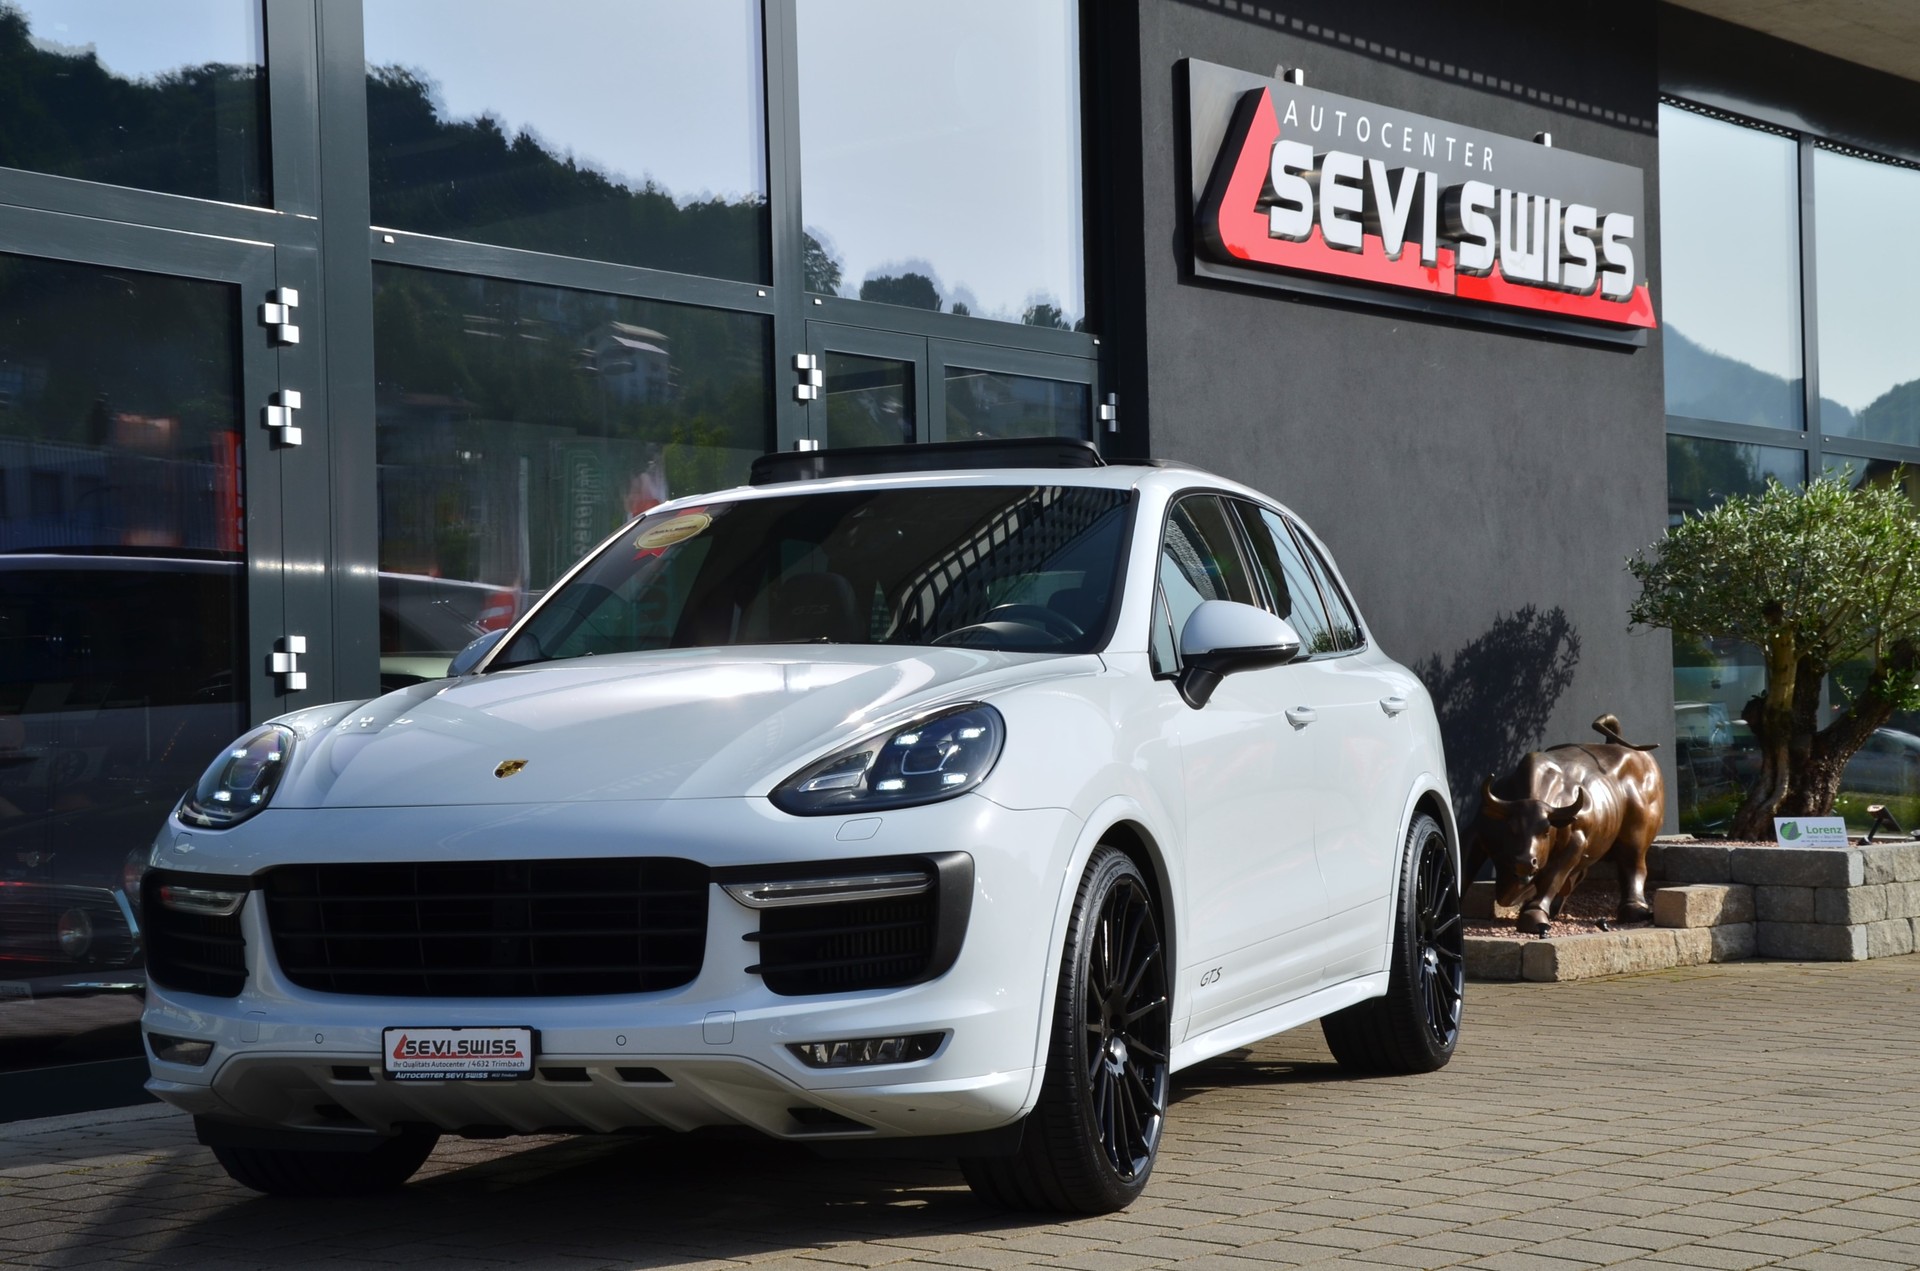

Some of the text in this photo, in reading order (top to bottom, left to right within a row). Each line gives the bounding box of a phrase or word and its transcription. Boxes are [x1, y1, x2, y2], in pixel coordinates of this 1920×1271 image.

[1283, 99, 1494, 173] AUTOCENTER
[1268, 139, 1635, 298] SEVI SWISS
[1805, 825, 1843, 835] Lorenz
[1200, 966, 1223, 987] GTS
[404, 1039, 517, 1055] SEVI SWISS
[431, 1060, 466, 1068] Autocenter
[491, 1060, 525, 1068] Trimbach
